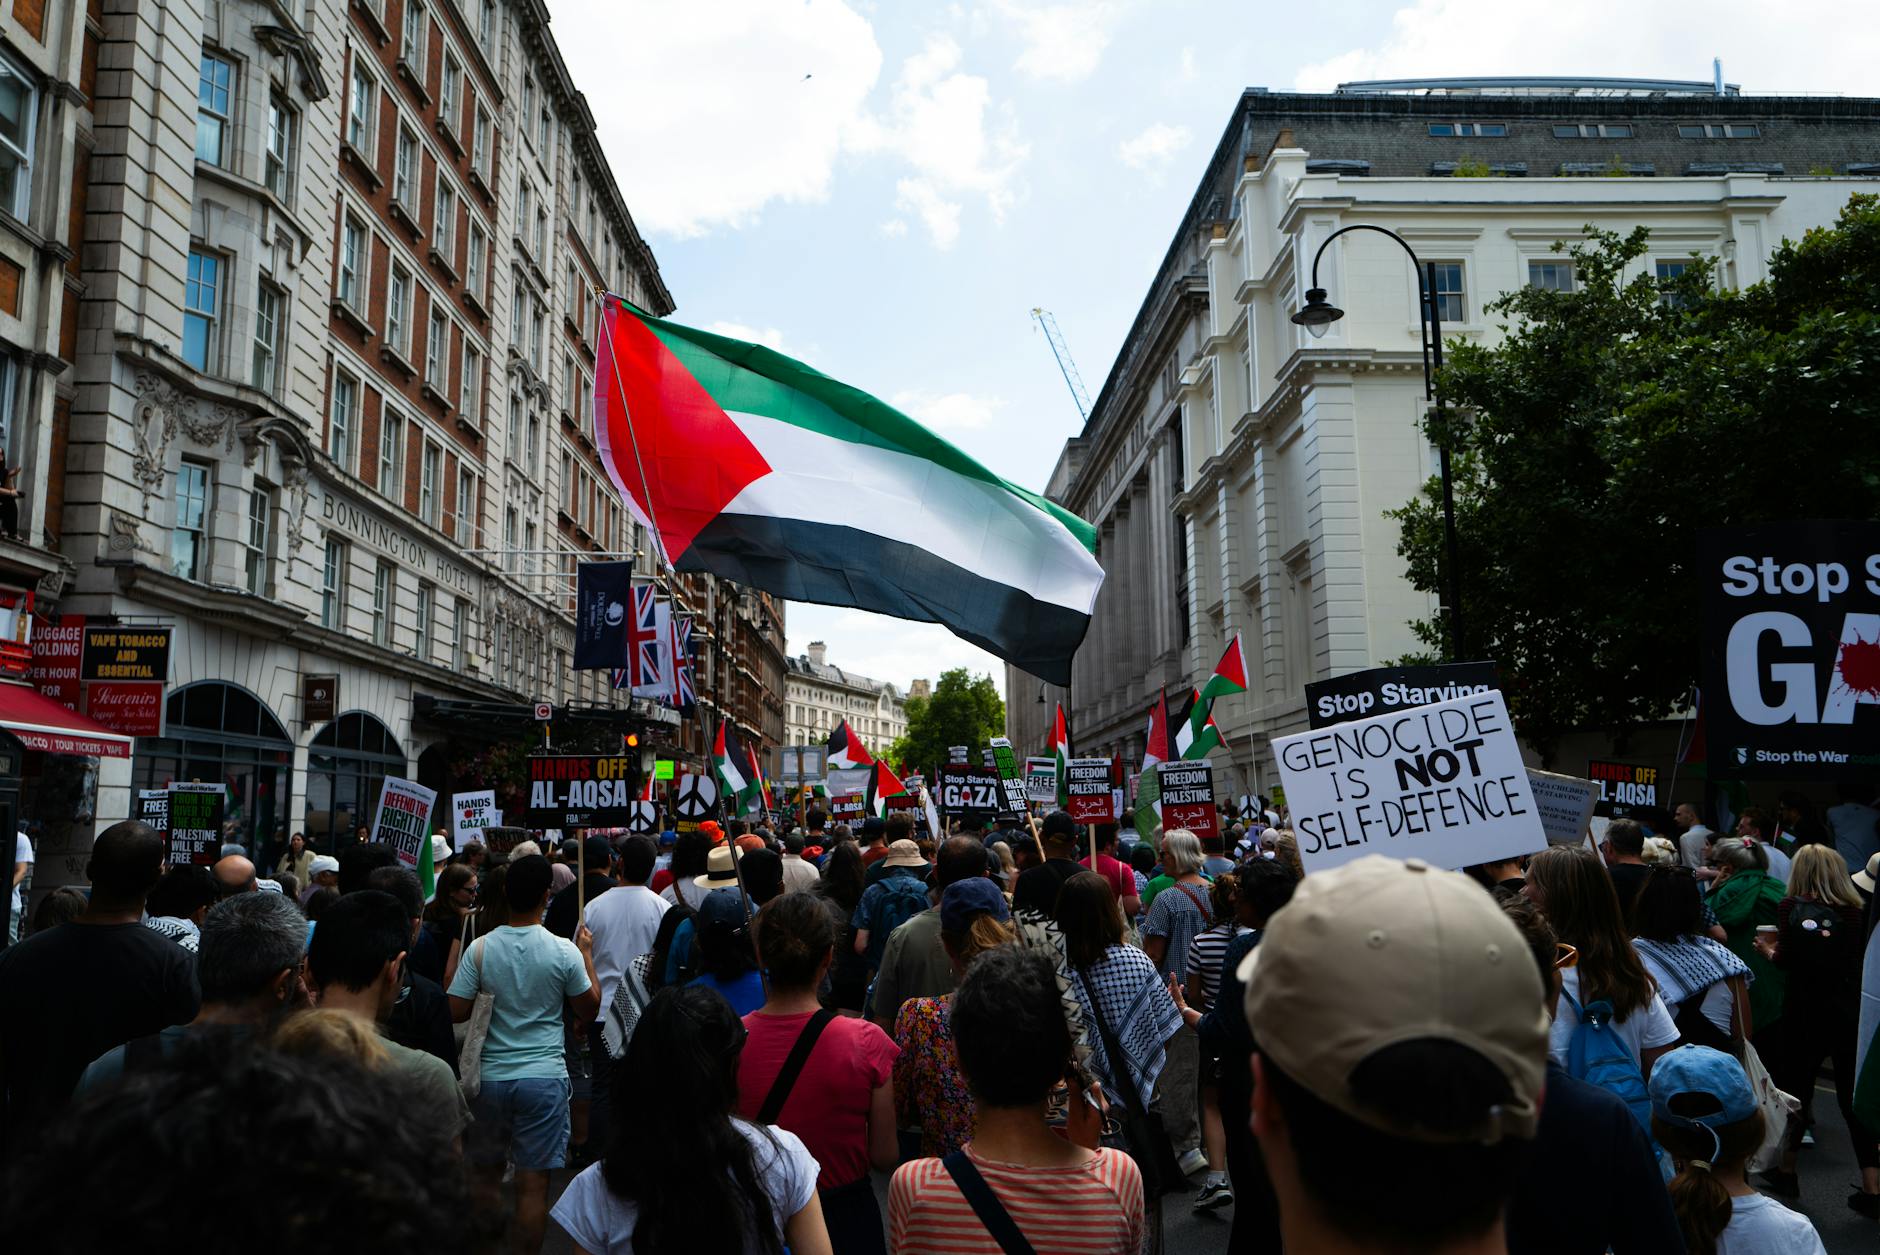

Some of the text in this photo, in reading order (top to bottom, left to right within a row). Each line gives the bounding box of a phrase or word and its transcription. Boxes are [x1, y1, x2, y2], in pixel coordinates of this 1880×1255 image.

[323, 493, 473, 595] BONNINGTON HOTEL
[1721, 555, 1850, 603] Stop
[31, 627, 80, 641] LUGGAGE
[90, 634, 166, 648] VAPE TOBACCO
[116, 649, 138, 662] AND
[49, 667, 77, 679] HOUR
[97, 663, 153, 678] ESSENTIAL
[41, 685, 60, 697] FOR
[93, 686, 156, 705] Souvenirs
[1317, 690, 1375, 718] Stop
[1282, 700, 1502, 772] GENOCIDE
[55, 739, 74, 751] TOUR
[75, 741, 100, 753] TICKETS
[106, 744, 122, 755] VAPE
[1756, 750, 1790, 765] Stop
[1792, 750, 1817, 762] the
[1819, 751, 1849, 763] War
[531, 757, 628, 781] HANDS OFF
[1070, 767, 1107, 779] FREEDOM
[1330, 738, 1484, 802] IS NOT
[1591, 762, 1657, 785] HANDS OFF
[945, 774, 965, 785] Stop
[1027, 776, 1055, 787] FREE
[1162, 770, 1207, 786] FREEDOM
[530, 779, 628, 810] AL-AQSA
[1069, 783, 1110, 795] PALESTINE
[1551, 783, 1589, 796] CHILDREN
[174, 793, 217, 805] FROM THE
[457, 797, 491, 810] HANDS
[944, 785, 998, 808] GAZA
[1076, 798, 1104, 809] الحرية
[1162, 789, 1212, 804] PALESTINE
[173, 805, 211, 817] RIVER TO
[383, 791, 429, 819] DEFEND THE
[1009, 800, 1028, 811] FREE
[1073, 808, 1108, 820] لفلسطين
[1172, 807, 1205, 821] الحرية
[1299, 775, 1527, 853] SELF-DEFENCE
[173, 817, 207, 829] THE SEA
[380, 806, 425, 838] RIGHT TO
[460, 817, 490, 829] GAZA!
[172, 828, 217, 841] PALESTINE
[376, 826, 422, 857] PROTEST
[171, 839, 205, 853] WILL BE
[170, 852, 191, 864] FREE
